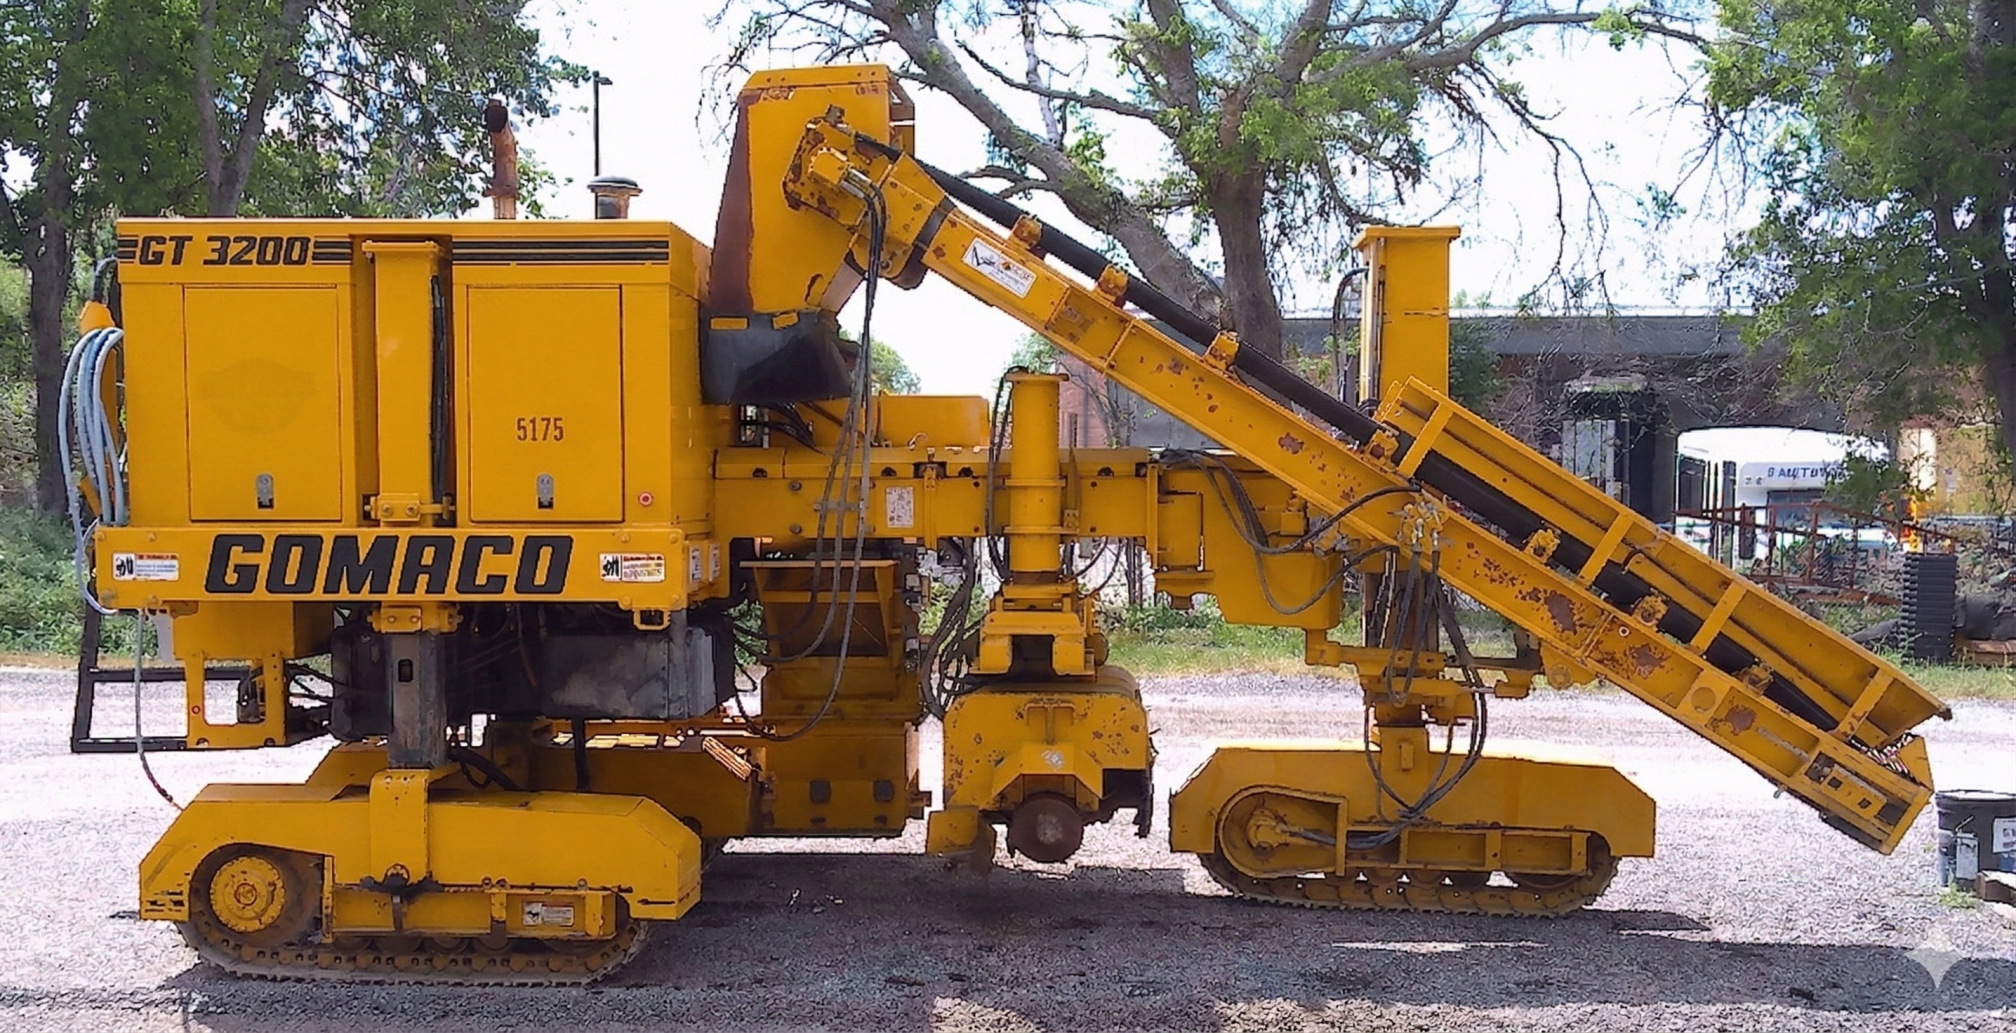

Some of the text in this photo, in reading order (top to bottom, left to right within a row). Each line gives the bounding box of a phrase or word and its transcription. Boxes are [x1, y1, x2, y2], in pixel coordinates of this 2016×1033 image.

[139, 235, 311, 265] GT 3200
[516, 416, 564, 442] 5175
[204, 534, 574, 595] GOMACO
